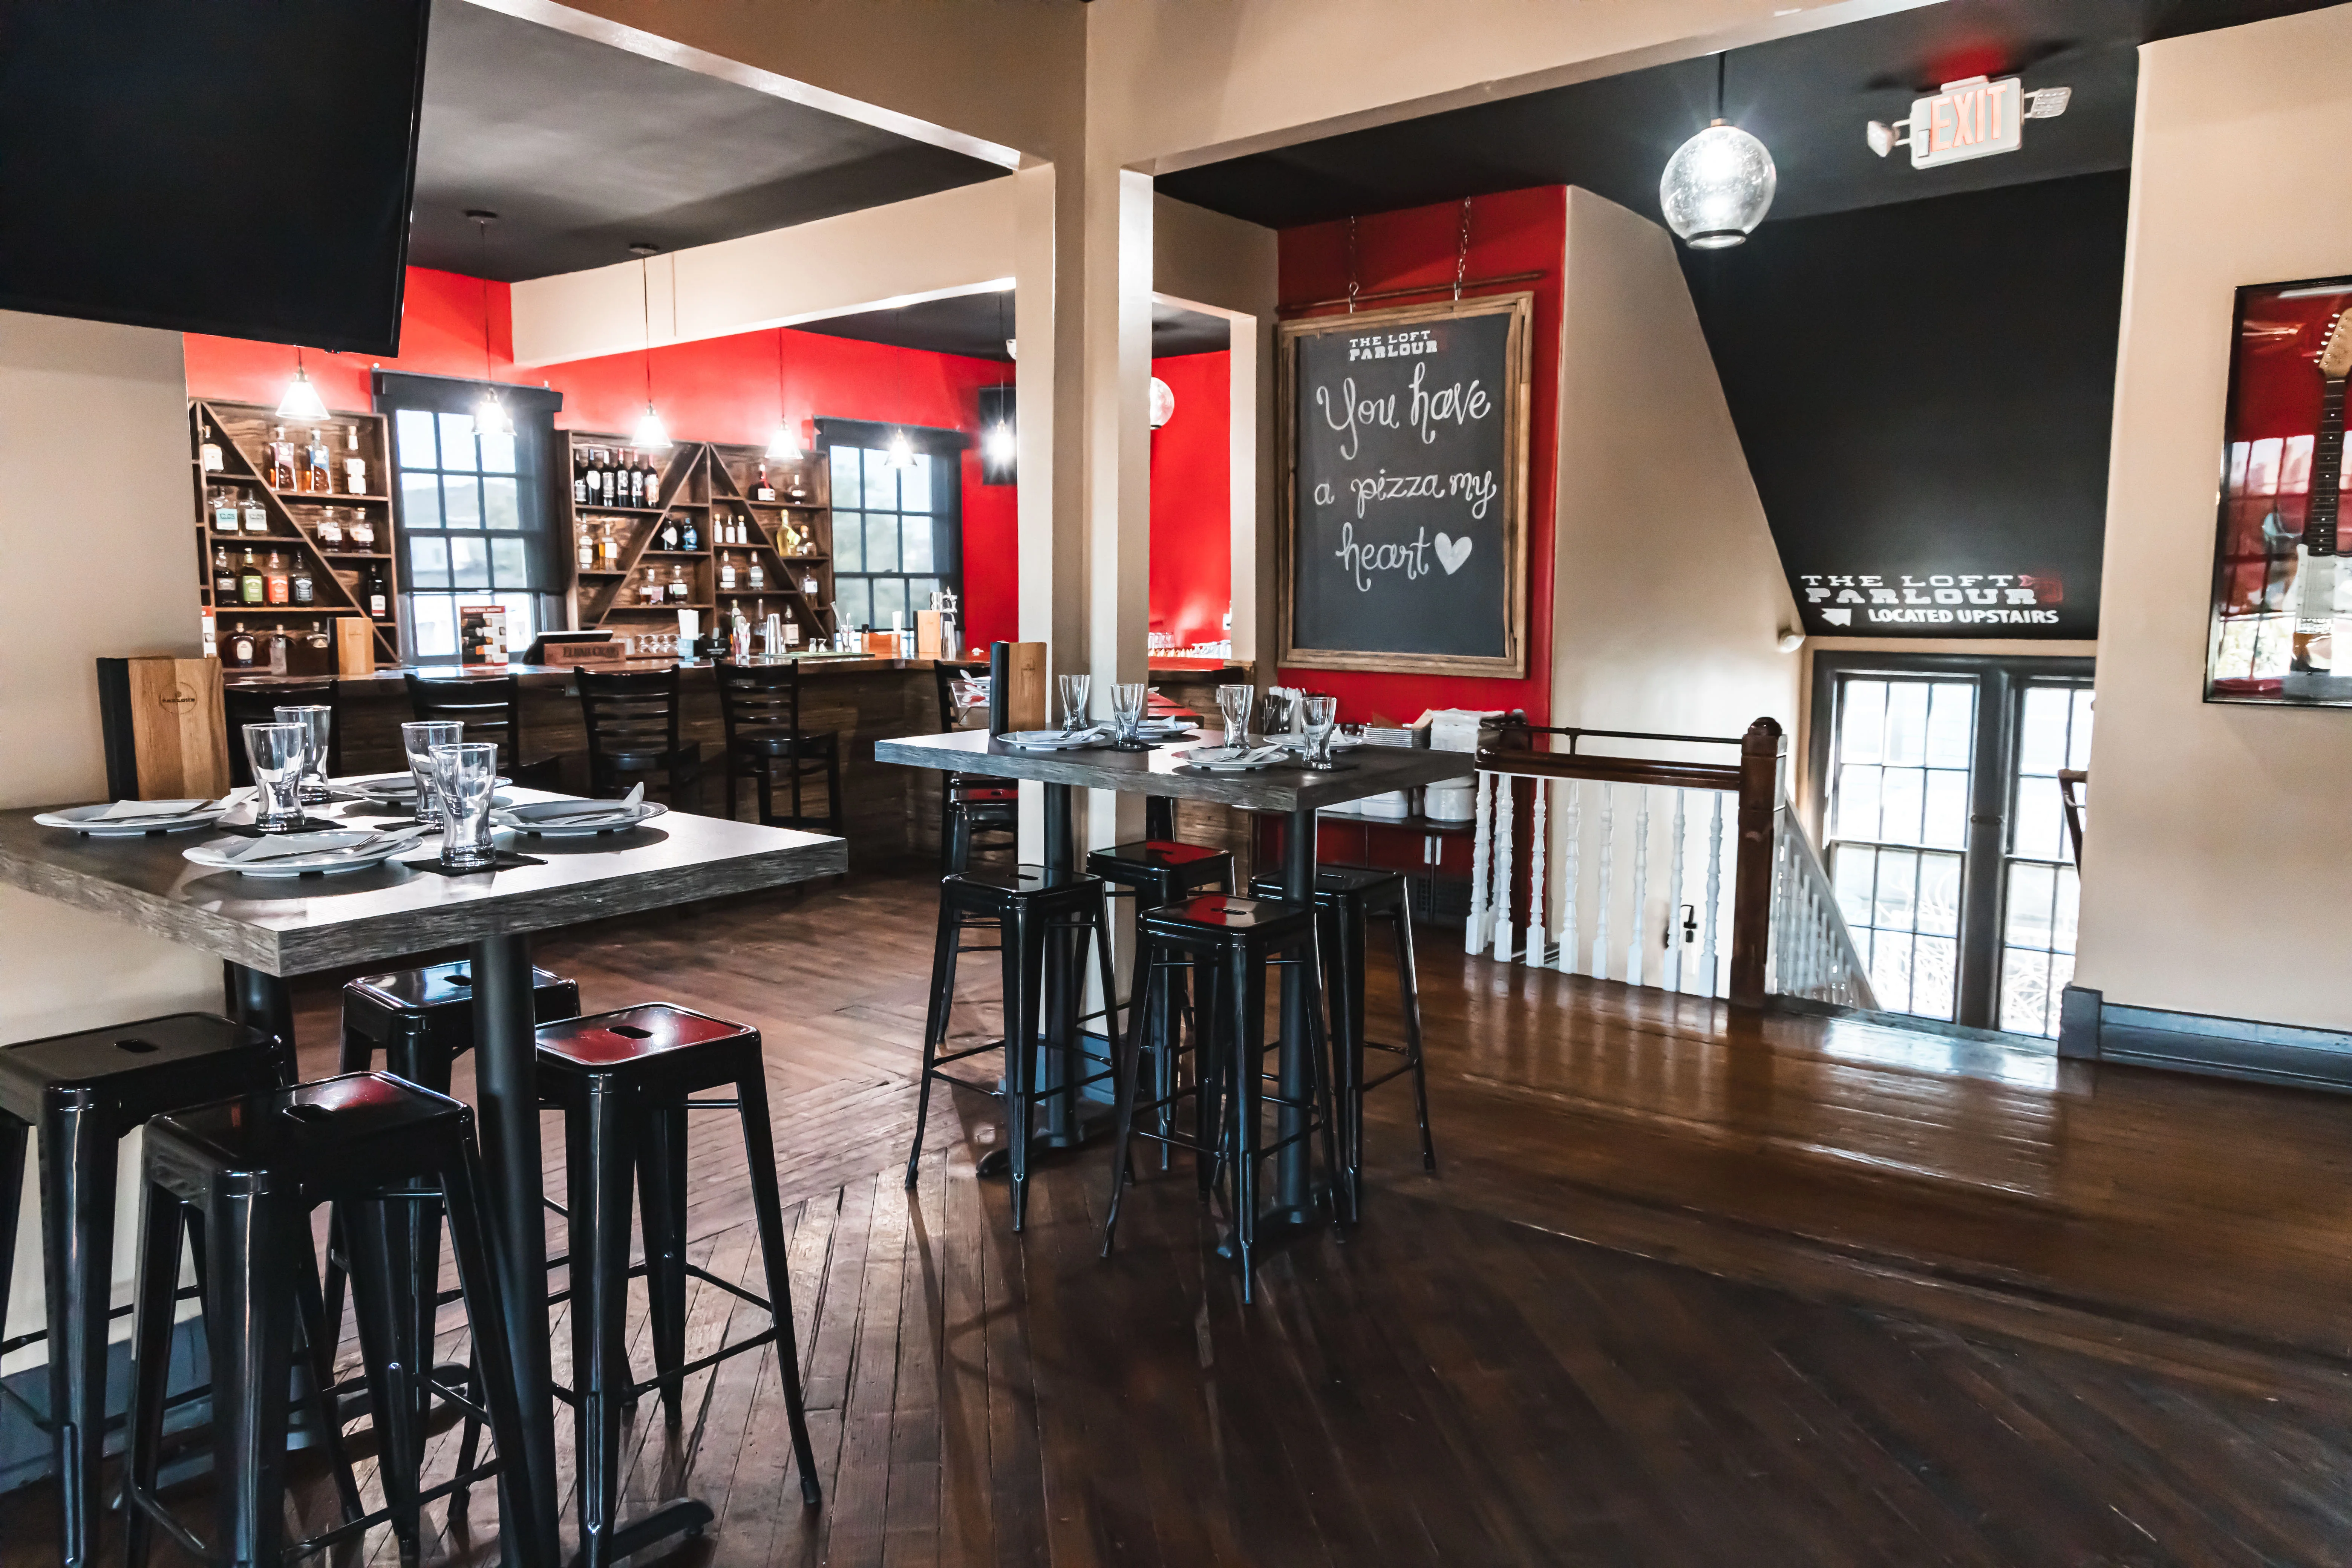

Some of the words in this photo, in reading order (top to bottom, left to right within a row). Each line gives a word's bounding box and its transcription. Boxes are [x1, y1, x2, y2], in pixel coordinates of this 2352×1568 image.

[1930, 84, 2007, 152] EXIT
[1349, 336, 1381, 348] THE
[1388, 330, 1430, 344] LOFT
[1349, 340, 1438, 361] PARLOUR
[1316, 377, 1400, 460] You
[1409, 361, 1491, 444] have
[1314, 483, 1335, 505] a
[1351, 468, 1445, 519] pizza
[1449, 470, 1497, 519] my
[1335, 522, 1431, 592] heart
[1801, 575, 1883, 587] THE
[1900, 575, 2014, 587] LOFT
[1805, 588, 2037, 605] PARLOUR
[1868, 608, 1954, 623] LOCATED
[1956, 609, 2060, 624] UPSTAIRS
